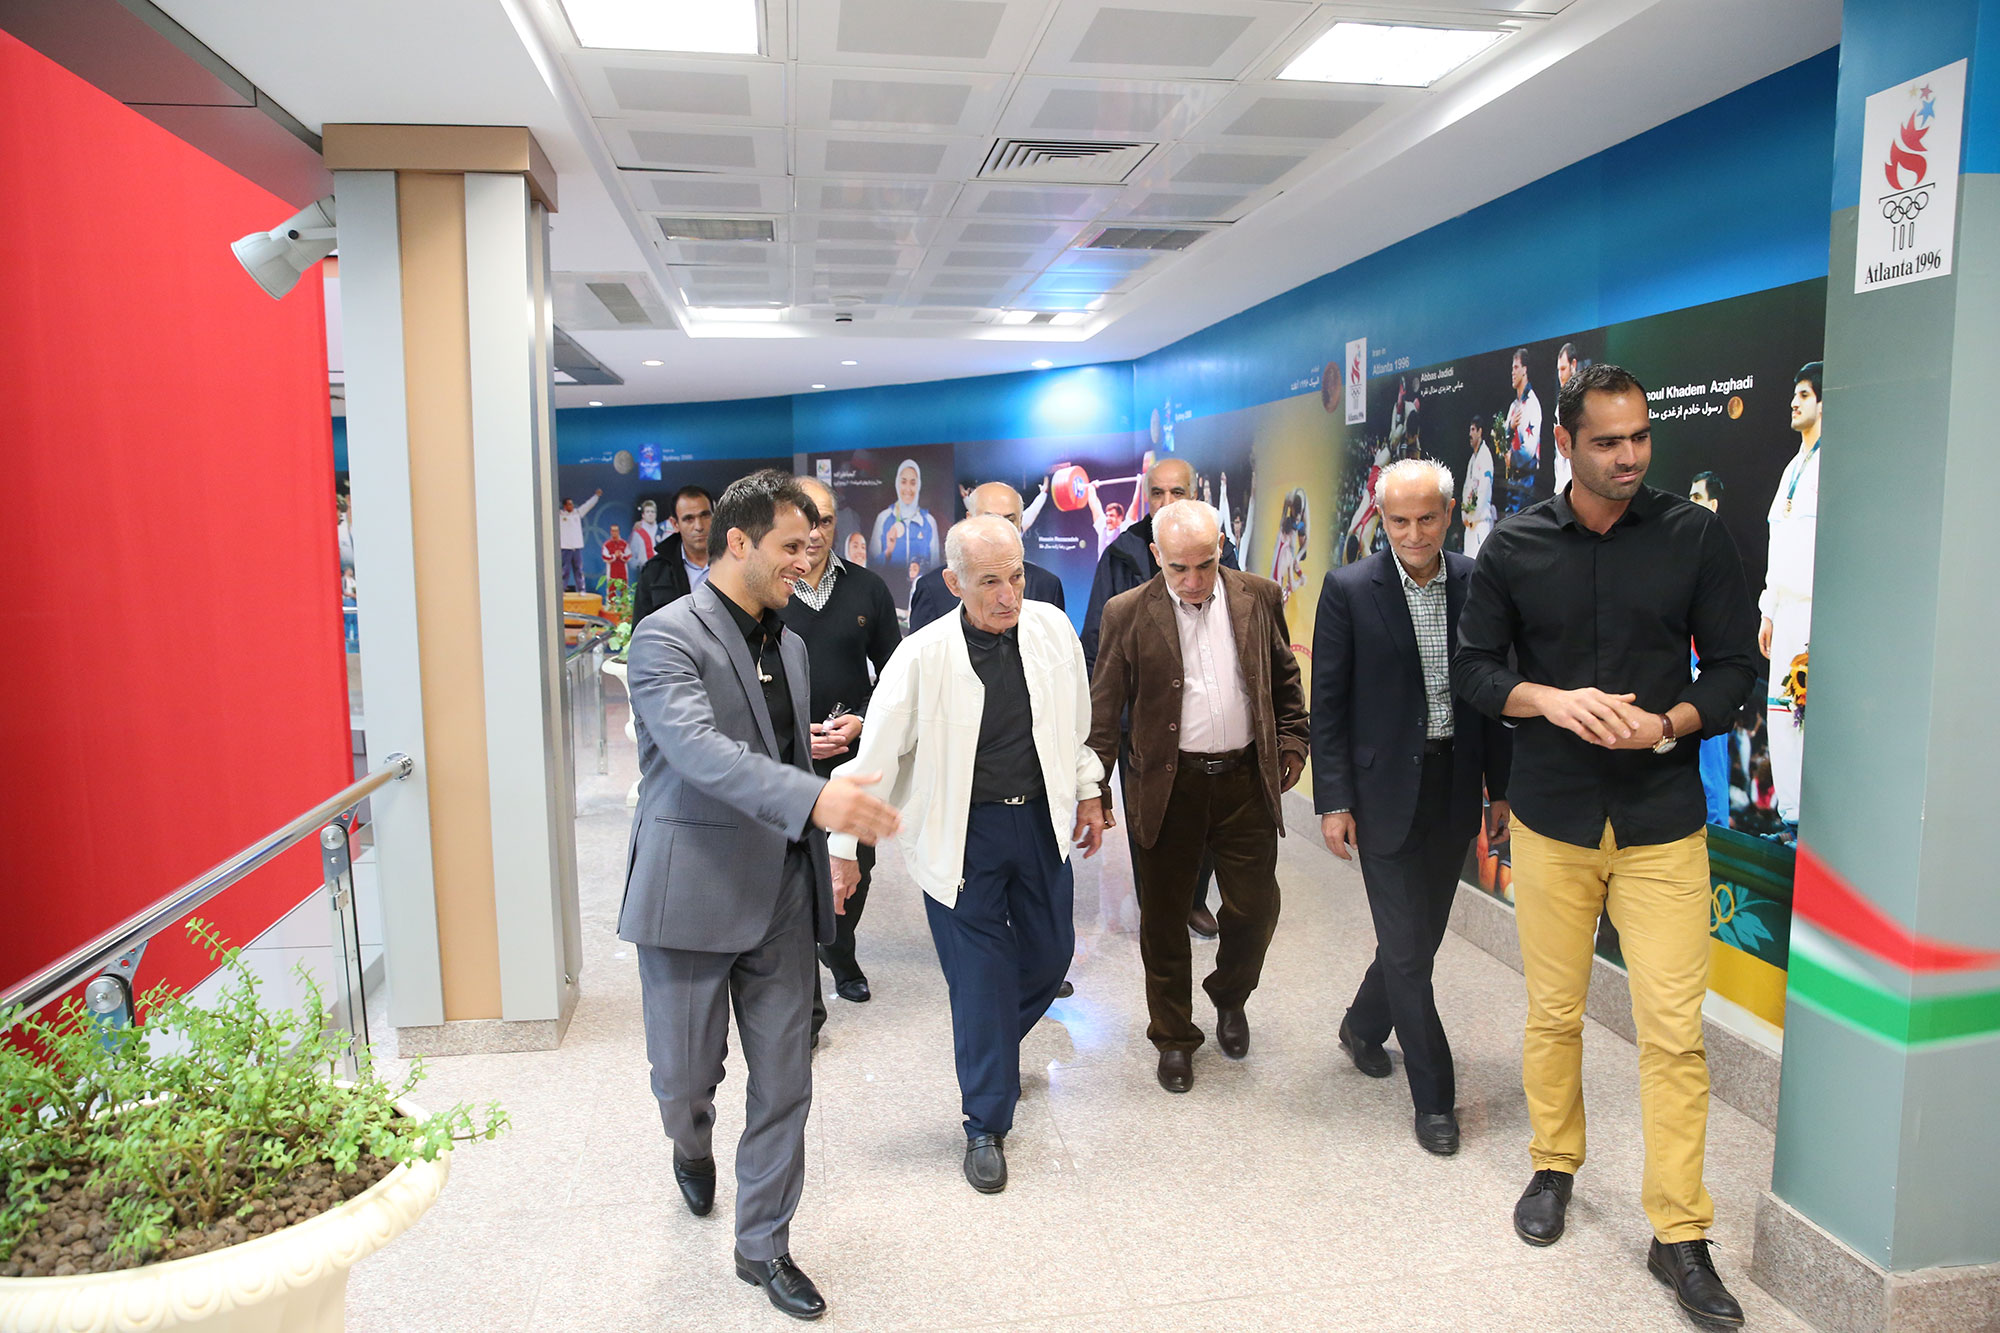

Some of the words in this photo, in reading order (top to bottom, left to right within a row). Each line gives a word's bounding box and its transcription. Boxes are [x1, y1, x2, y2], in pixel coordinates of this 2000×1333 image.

[1864, 259, 1913, 285] Atlanta
[1915, 248, 1942, 274] 1996
[1372, 361, 1394, 376] Atlanta
[1394, 356, 1410, 370] 1996
[1420, 371, 1437, 383] Abbas
[1437, 367, 1454, 379] Jadidi
[1646, 387, 1665, 402] soul
[1666, 383, 1706, 399] Khadem
[1709, 375, 1754, 395] Azghadi
[1648, 408, 1660, 419] مدا
[1660, 405, 1683, 421] ازغدی
[1683, 403, 1701, 420] خادم
[1702, 402, 1723, 417] رسول
